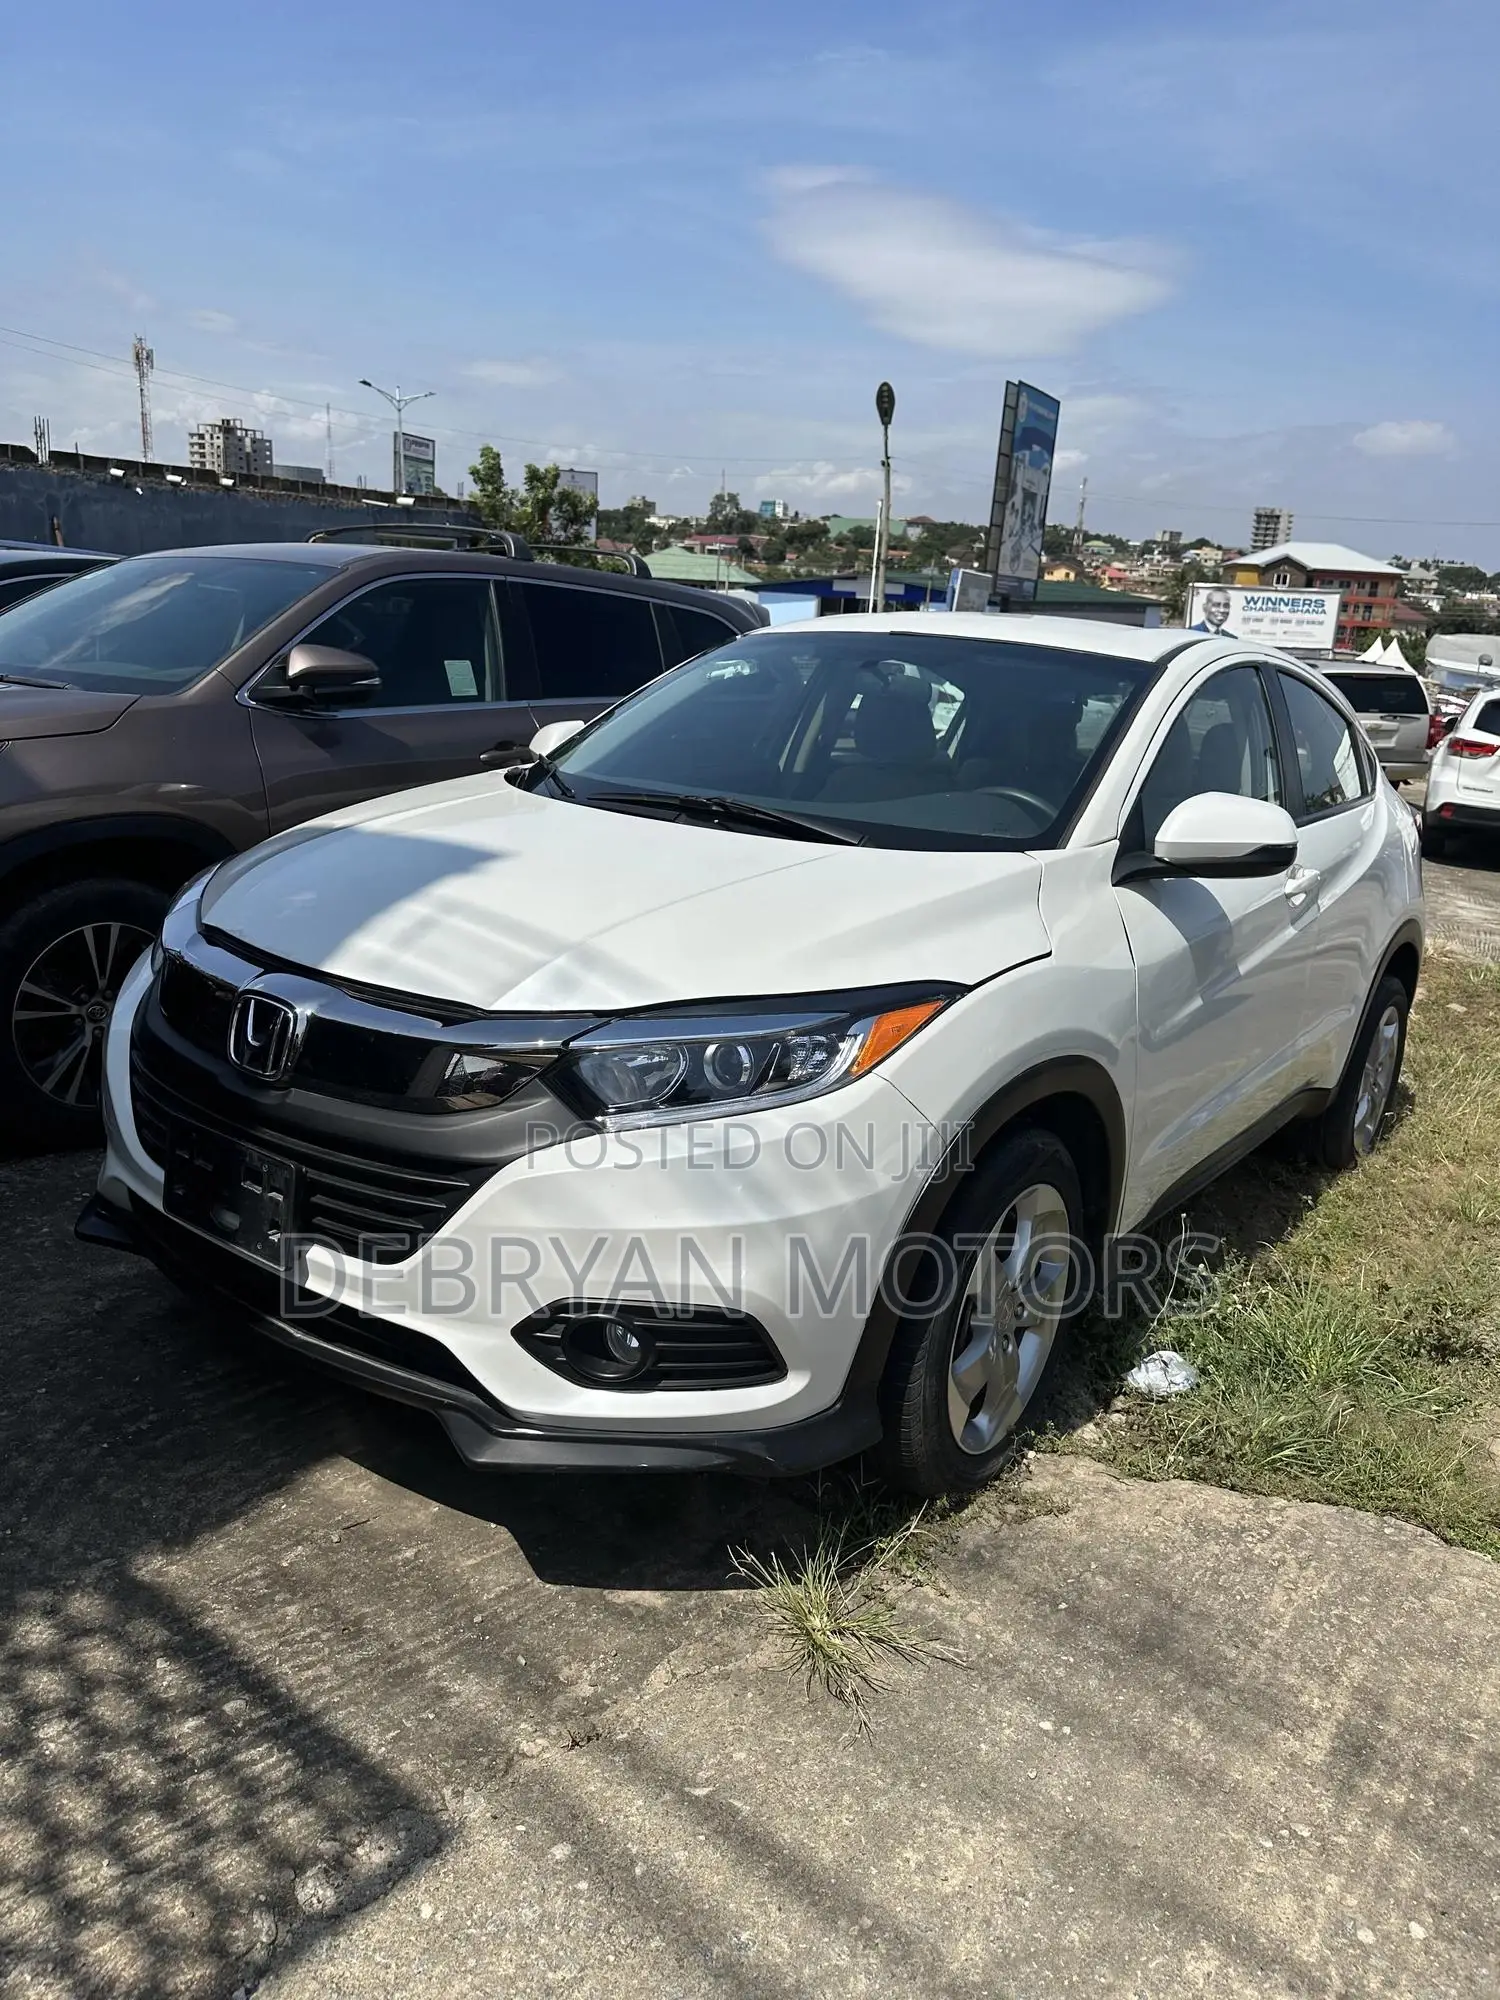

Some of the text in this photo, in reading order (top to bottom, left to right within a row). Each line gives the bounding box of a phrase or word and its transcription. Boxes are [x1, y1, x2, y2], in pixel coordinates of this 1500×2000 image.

[1244, 595, 1326, 608] WINNERS
[1242, 605, 1327, 615] CHAPEL GHANA
